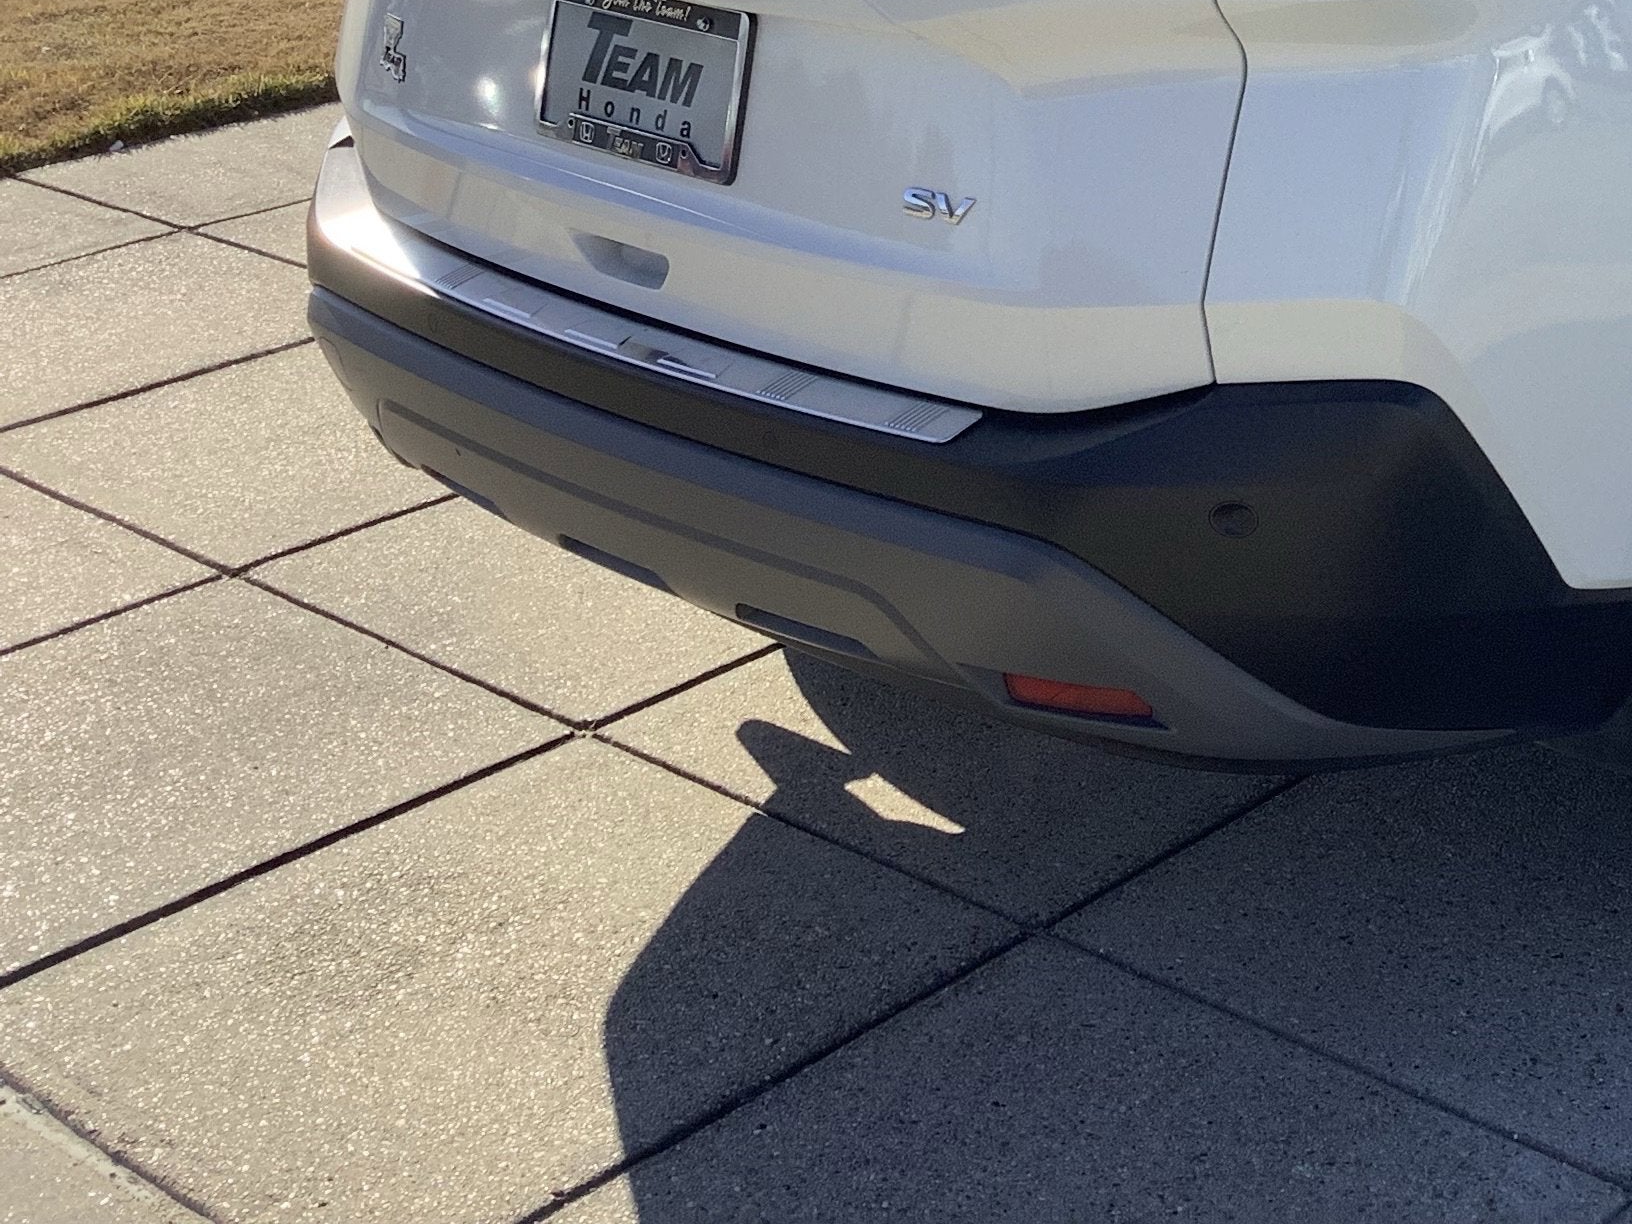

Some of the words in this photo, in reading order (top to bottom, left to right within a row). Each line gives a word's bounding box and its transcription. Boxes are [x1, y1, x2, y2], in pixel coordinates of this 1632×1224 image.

[582, 11, 704, 108] TEAM
[578, 87, 692, 140] Honda
[903, 187, 977, 226] SV
